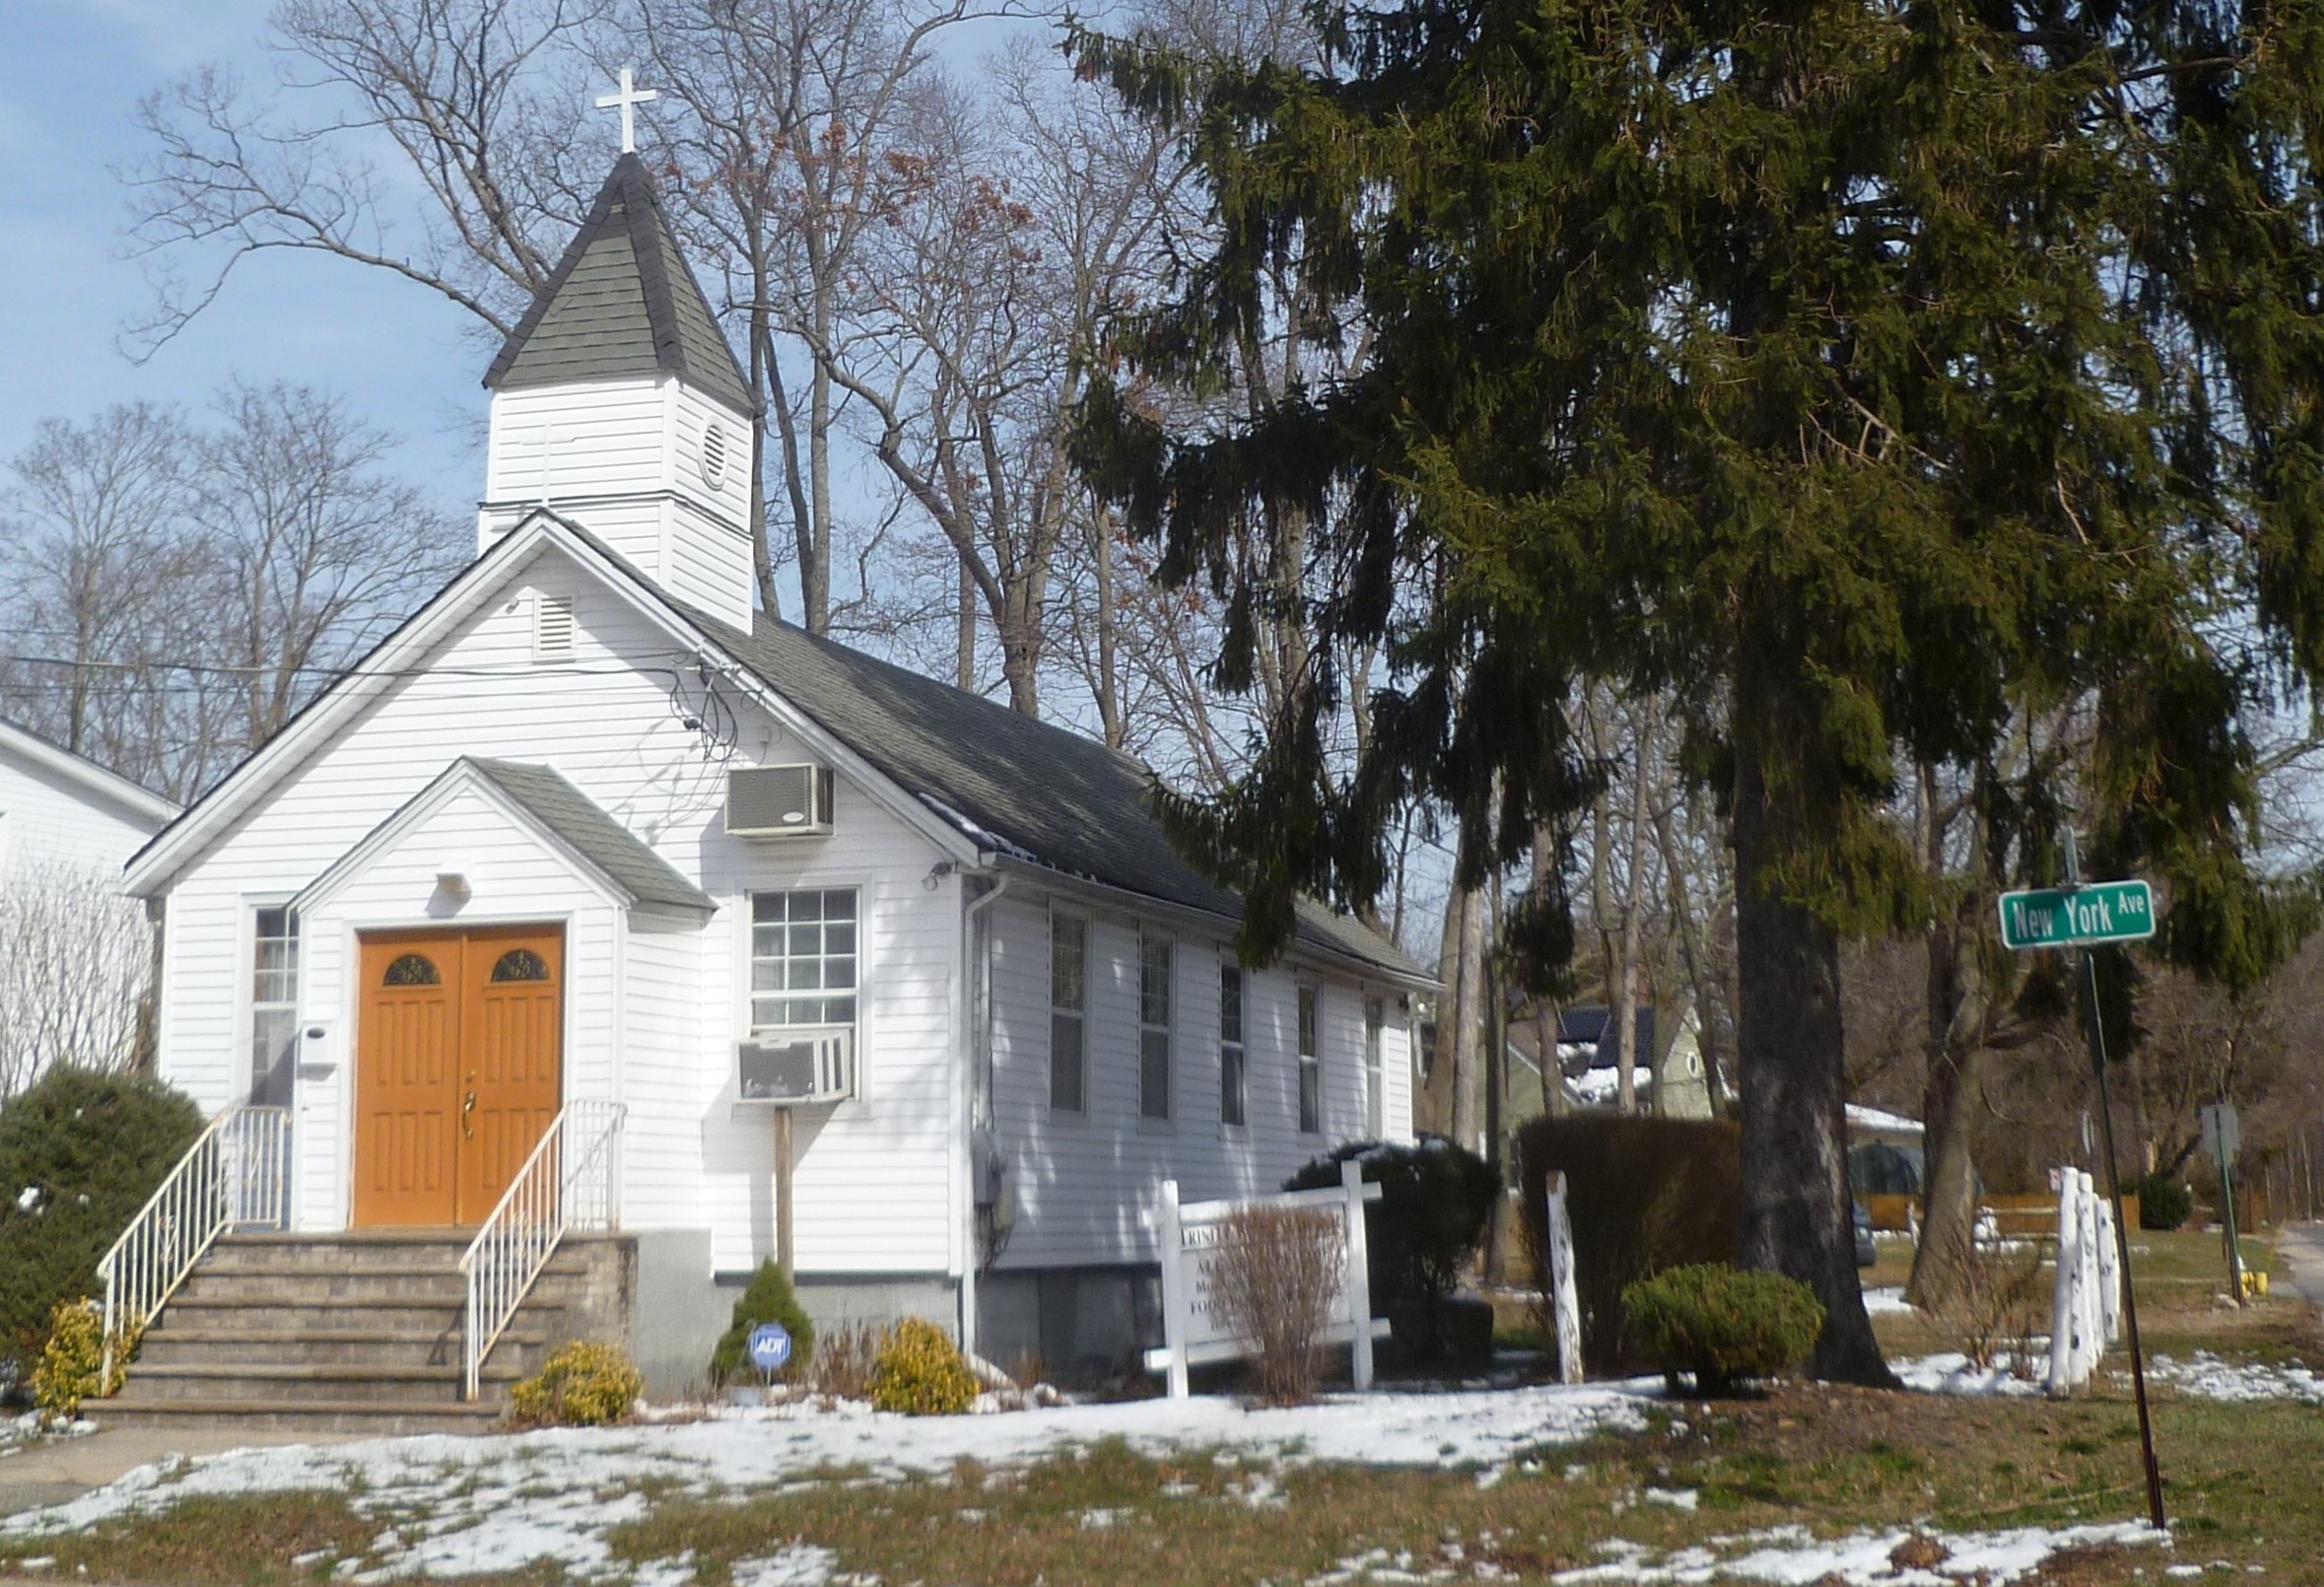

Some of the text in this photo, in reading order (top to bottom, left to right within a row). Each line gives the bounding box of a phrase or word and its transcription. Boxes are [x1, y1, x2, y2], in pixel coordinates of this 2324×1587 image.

[2013, 890, 2146, 939] New York Ave
[755, 1337, 786, 1354] ADT
